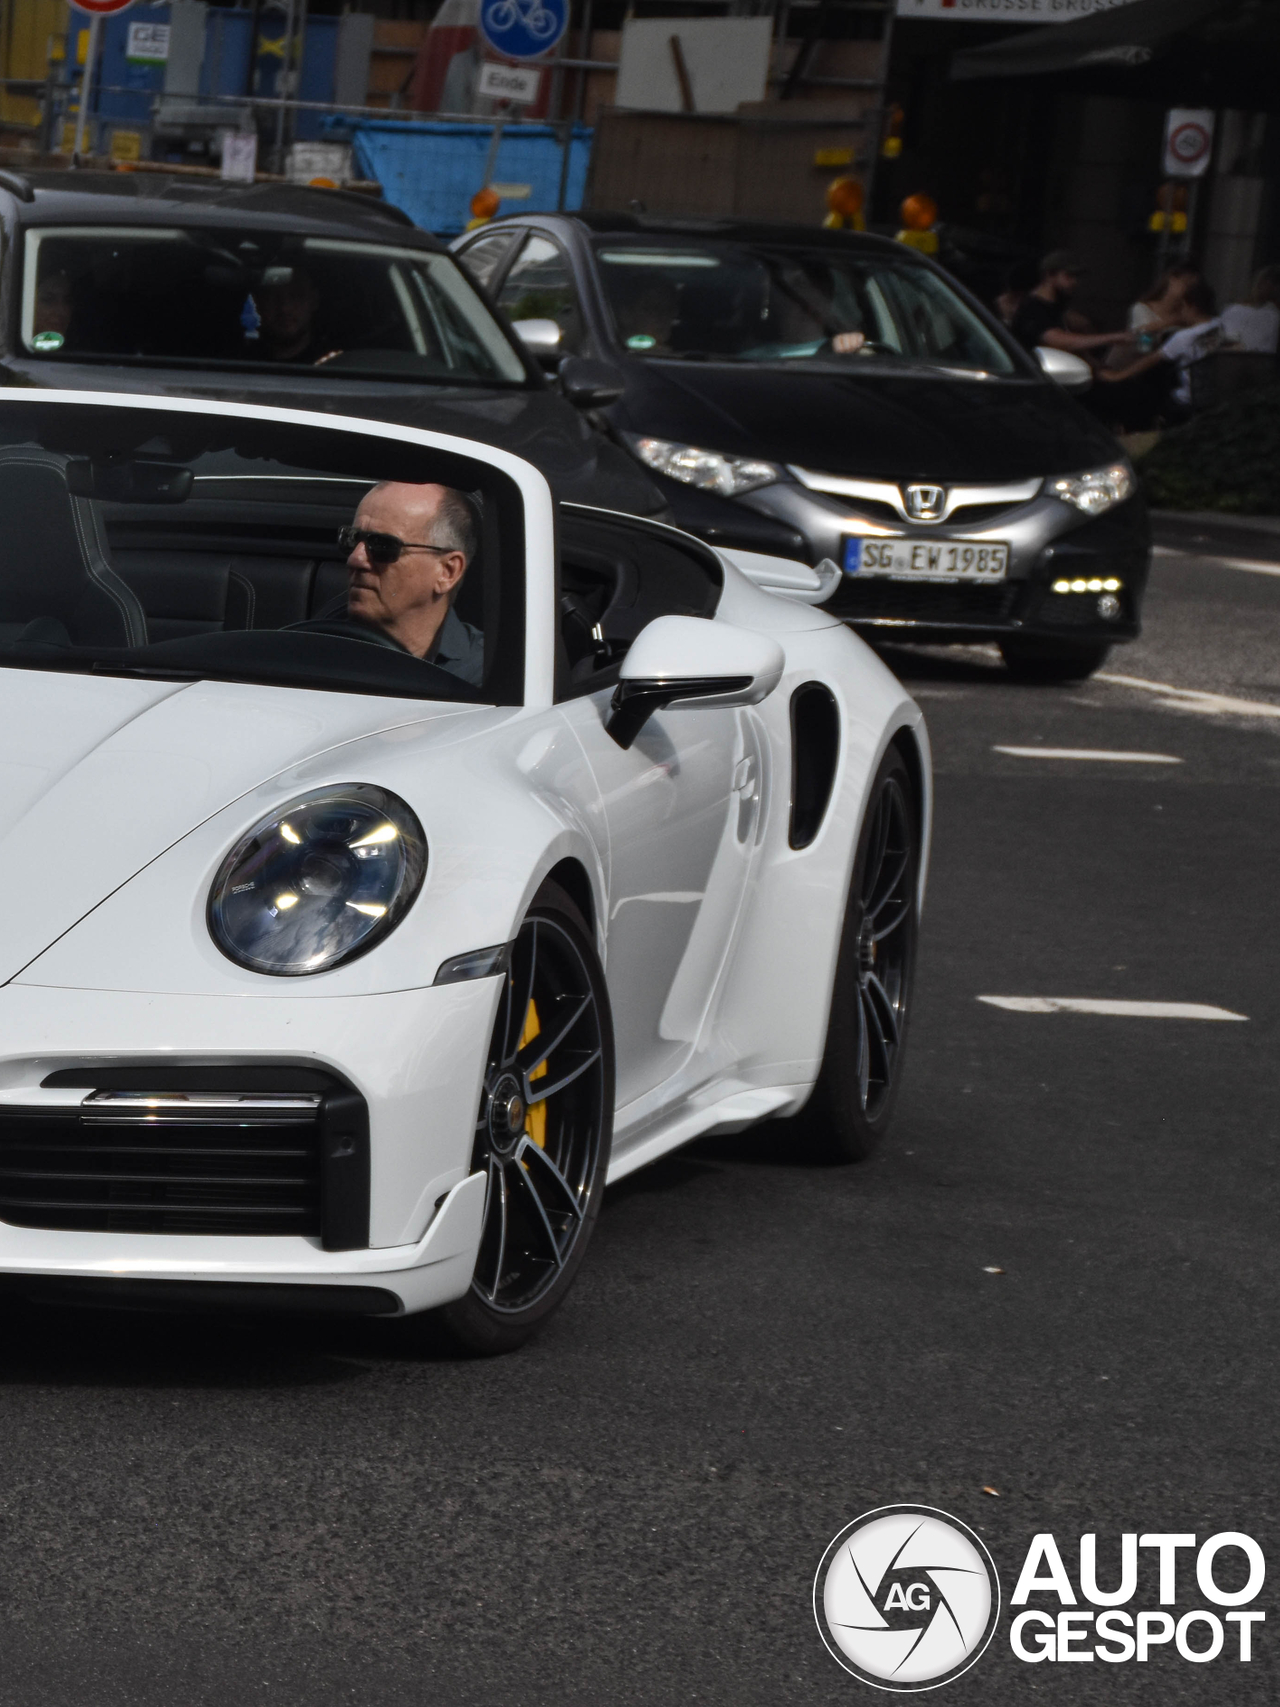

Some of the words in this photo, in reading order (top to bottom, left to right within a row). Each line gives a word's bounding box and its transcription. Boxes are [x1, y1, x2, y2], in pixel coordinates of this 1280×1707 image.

[488, 71, 527, 91] Ende
[862, 543, 894, 568] SG
[910, 545, 942, 570] EW
[946, 547, 1005, 574] 1985
